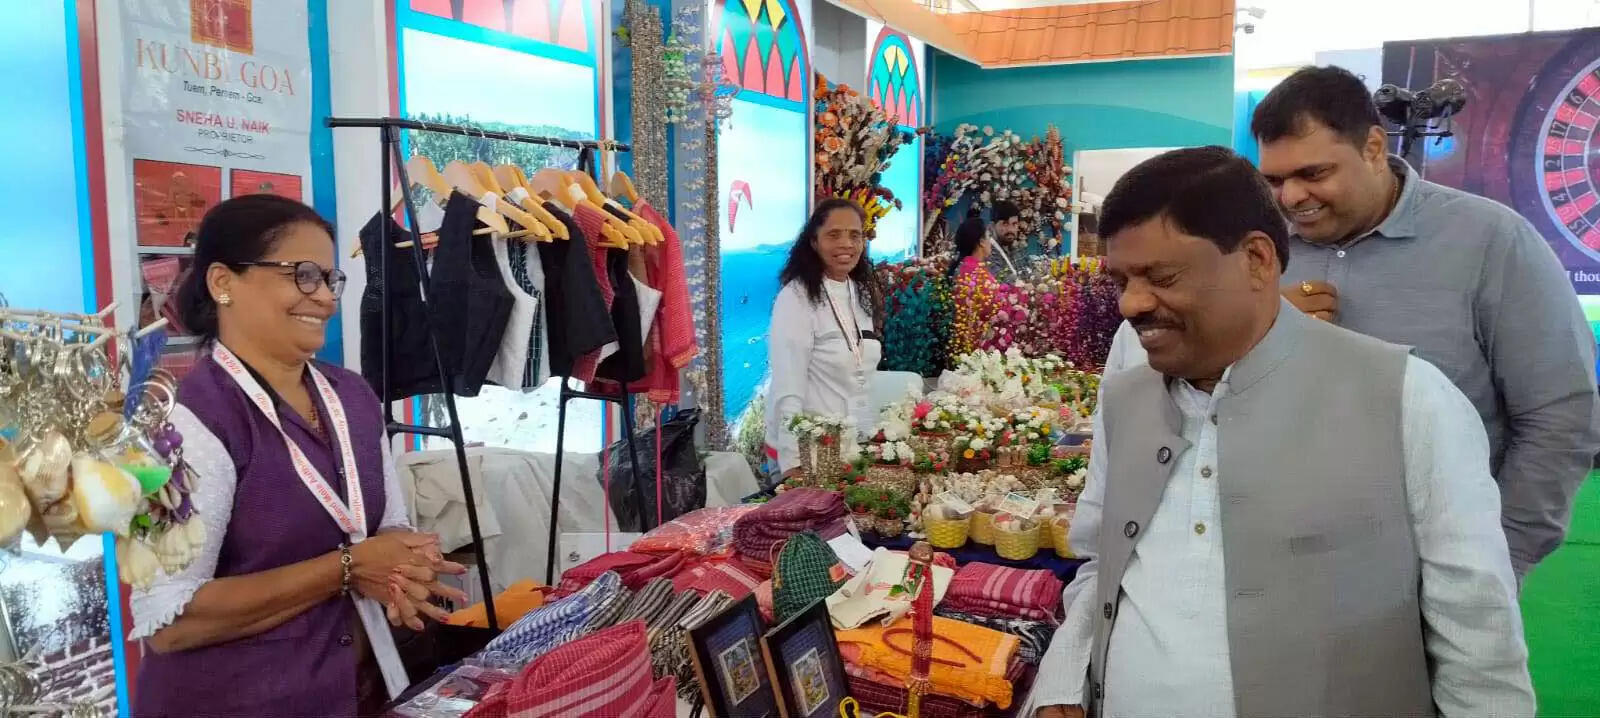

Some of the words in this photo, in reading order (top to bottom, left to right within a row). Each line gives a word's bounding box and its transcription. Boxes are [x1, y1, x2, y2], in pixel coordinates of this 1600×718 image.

[136, 39, 232, 83] KUNBI
[240, 61, 296, 95] GOA
[1570, 91, 1584, 104] 6
[176, 108, 223, 127] SNEHA
[241, 118, 270, 134] NAIK
[1550, 120, 1566, 137] 17
[198, 128, 253, 144] PROPRIETOR
[1545, 159, 1561, 168] 2
[1551, 192, 1569, 201] 4
[1568, 218, 1589, 235] 15
